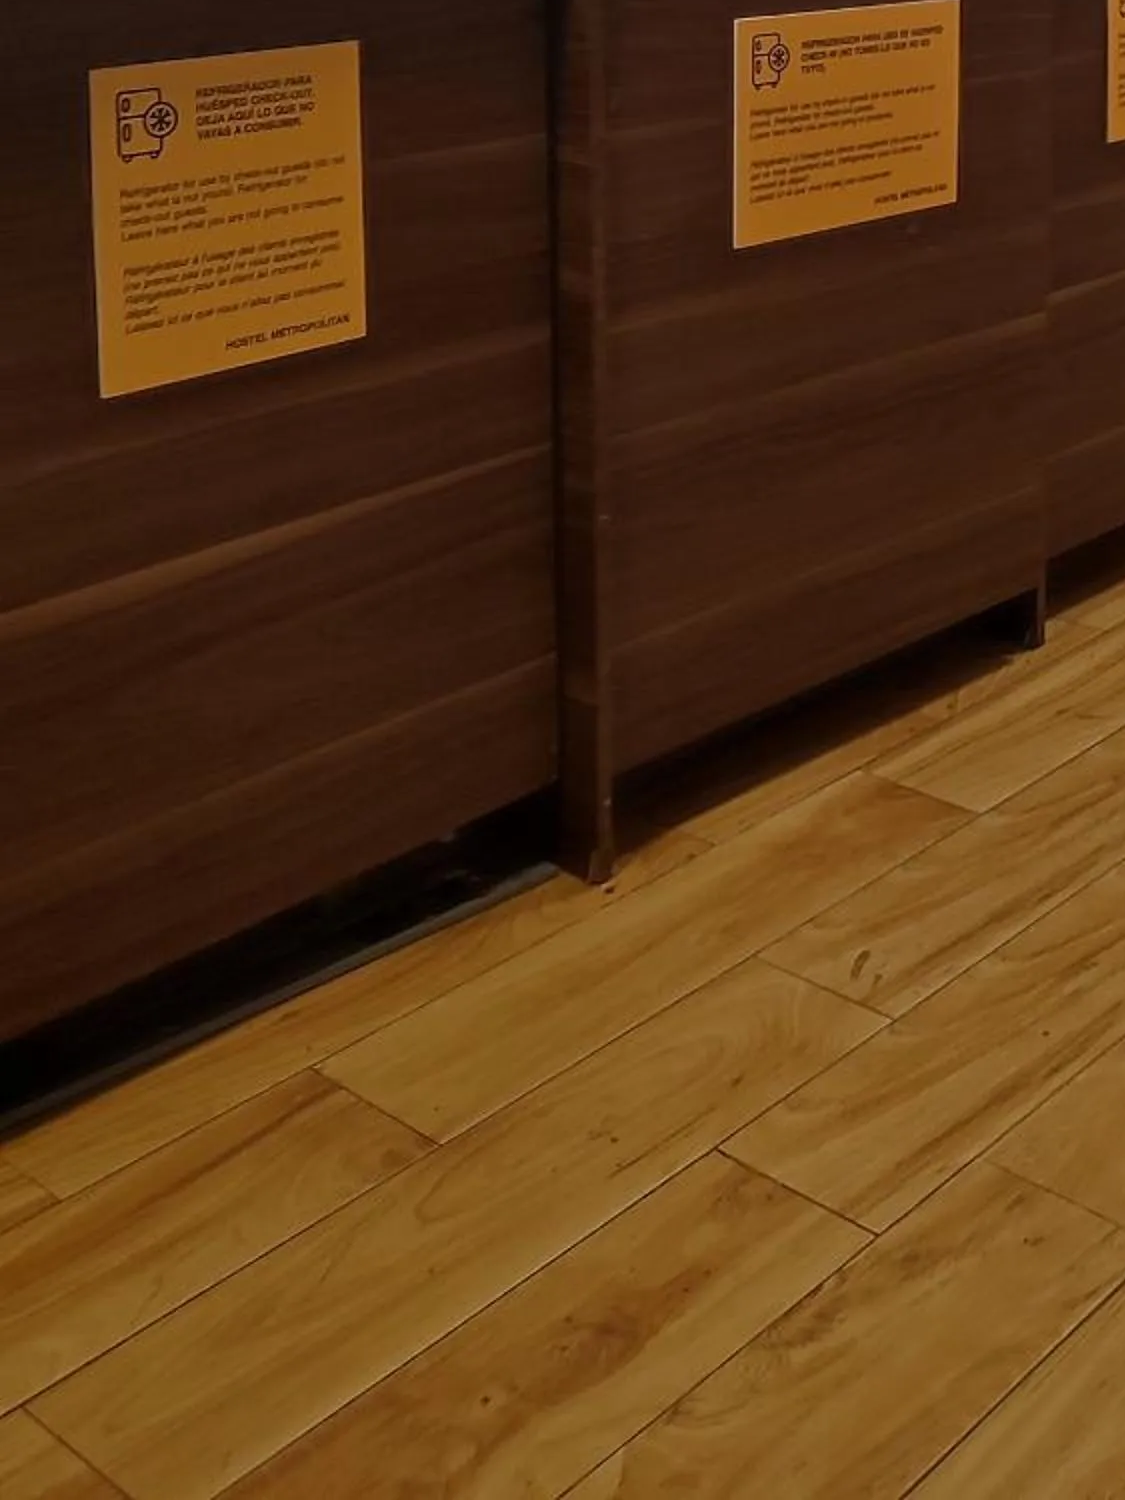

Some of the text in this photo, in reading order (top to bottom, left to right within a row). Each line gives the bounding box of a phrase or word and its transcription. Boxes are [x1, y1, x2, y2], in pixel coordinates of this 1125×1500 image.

[257, 107, 271, 118] LO
[225, 314, 350, 349] HOSTEL METROPOLITAN
